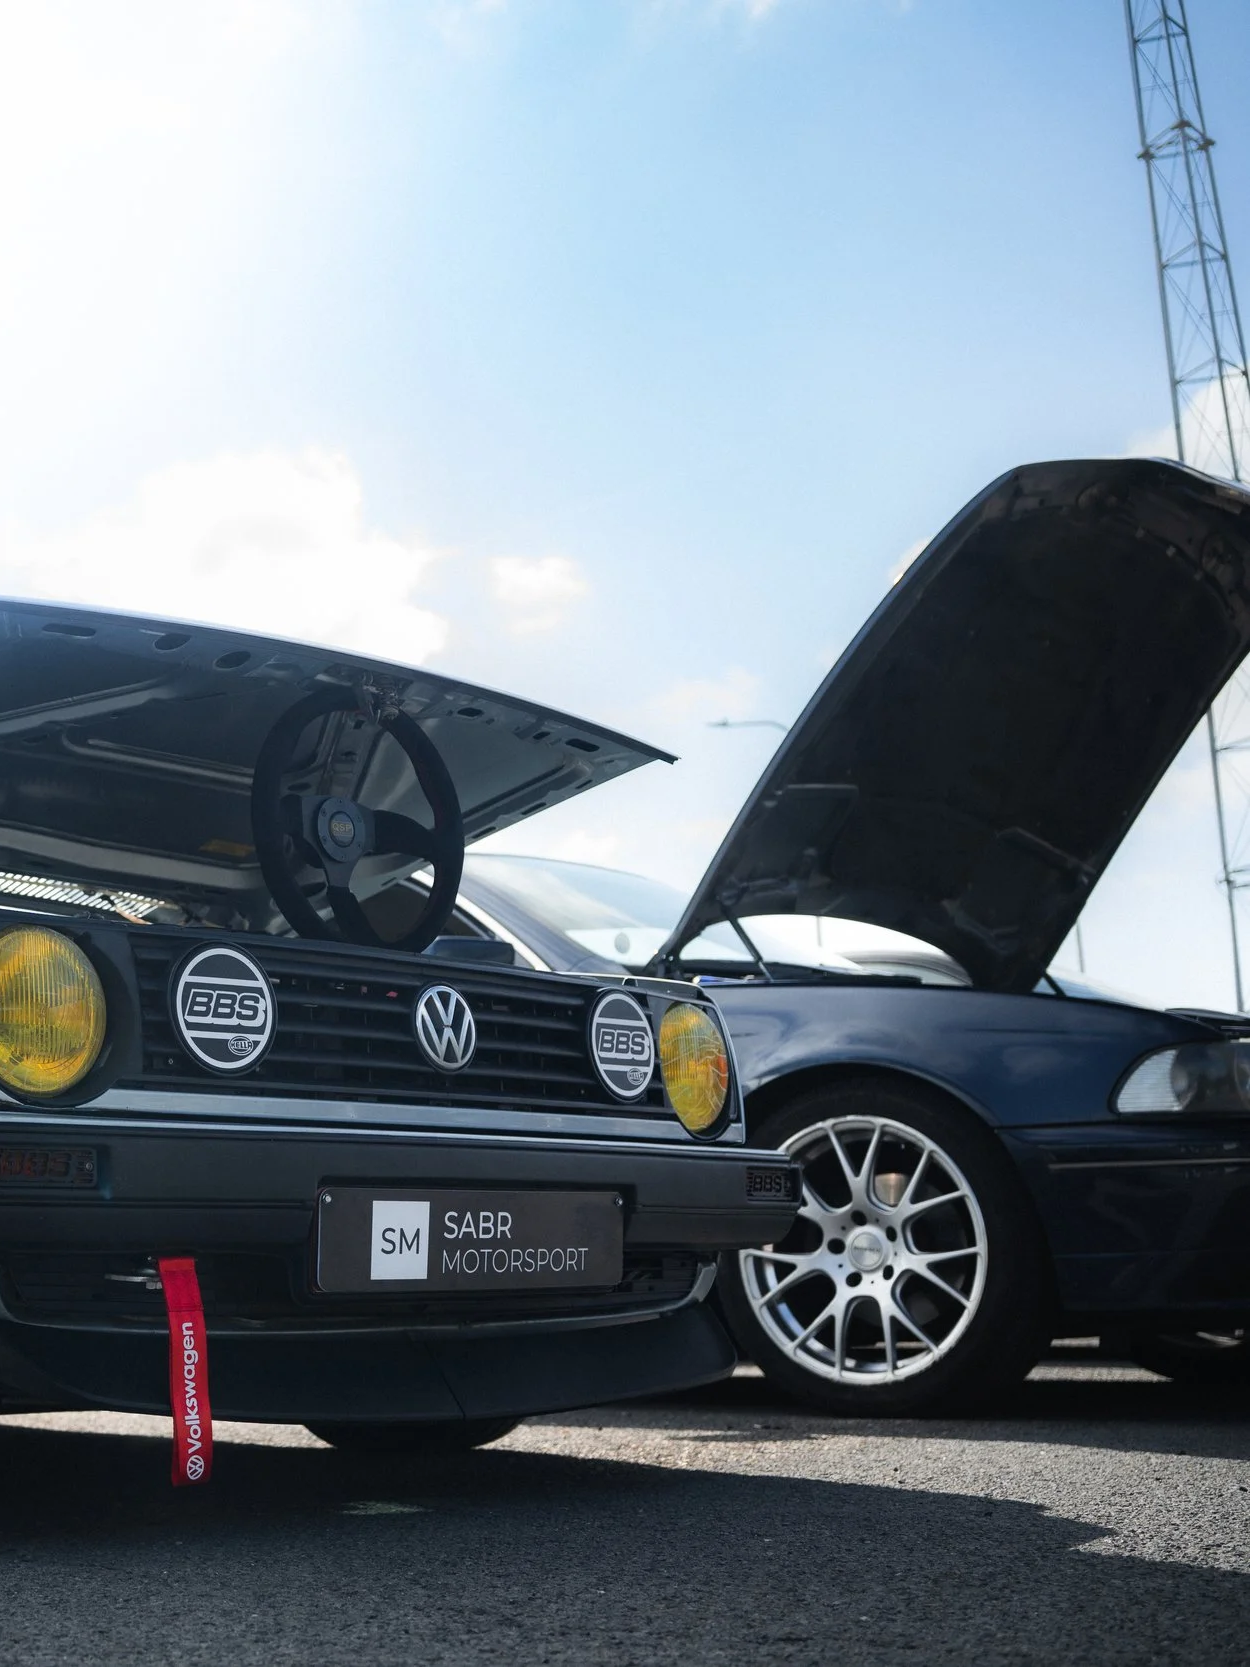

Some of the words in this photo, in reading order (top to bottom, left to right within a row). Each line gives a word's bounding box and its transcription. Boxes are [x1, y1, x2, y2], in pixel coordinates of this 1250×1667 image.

[184, 989, 266, 1027] BBS
[416, 985, 475, 1069] VW
[598, 1028, 650, 1061] BBS
[752, 1174, 783, 1195] BBS
[443, 1211, 513, 1239] SABR
[380, 1227, 420, 1255] SM
[442, 1247, 589, 1274] MOTORSPORT
[182, 1322, 202, 1454] Volkswagen
